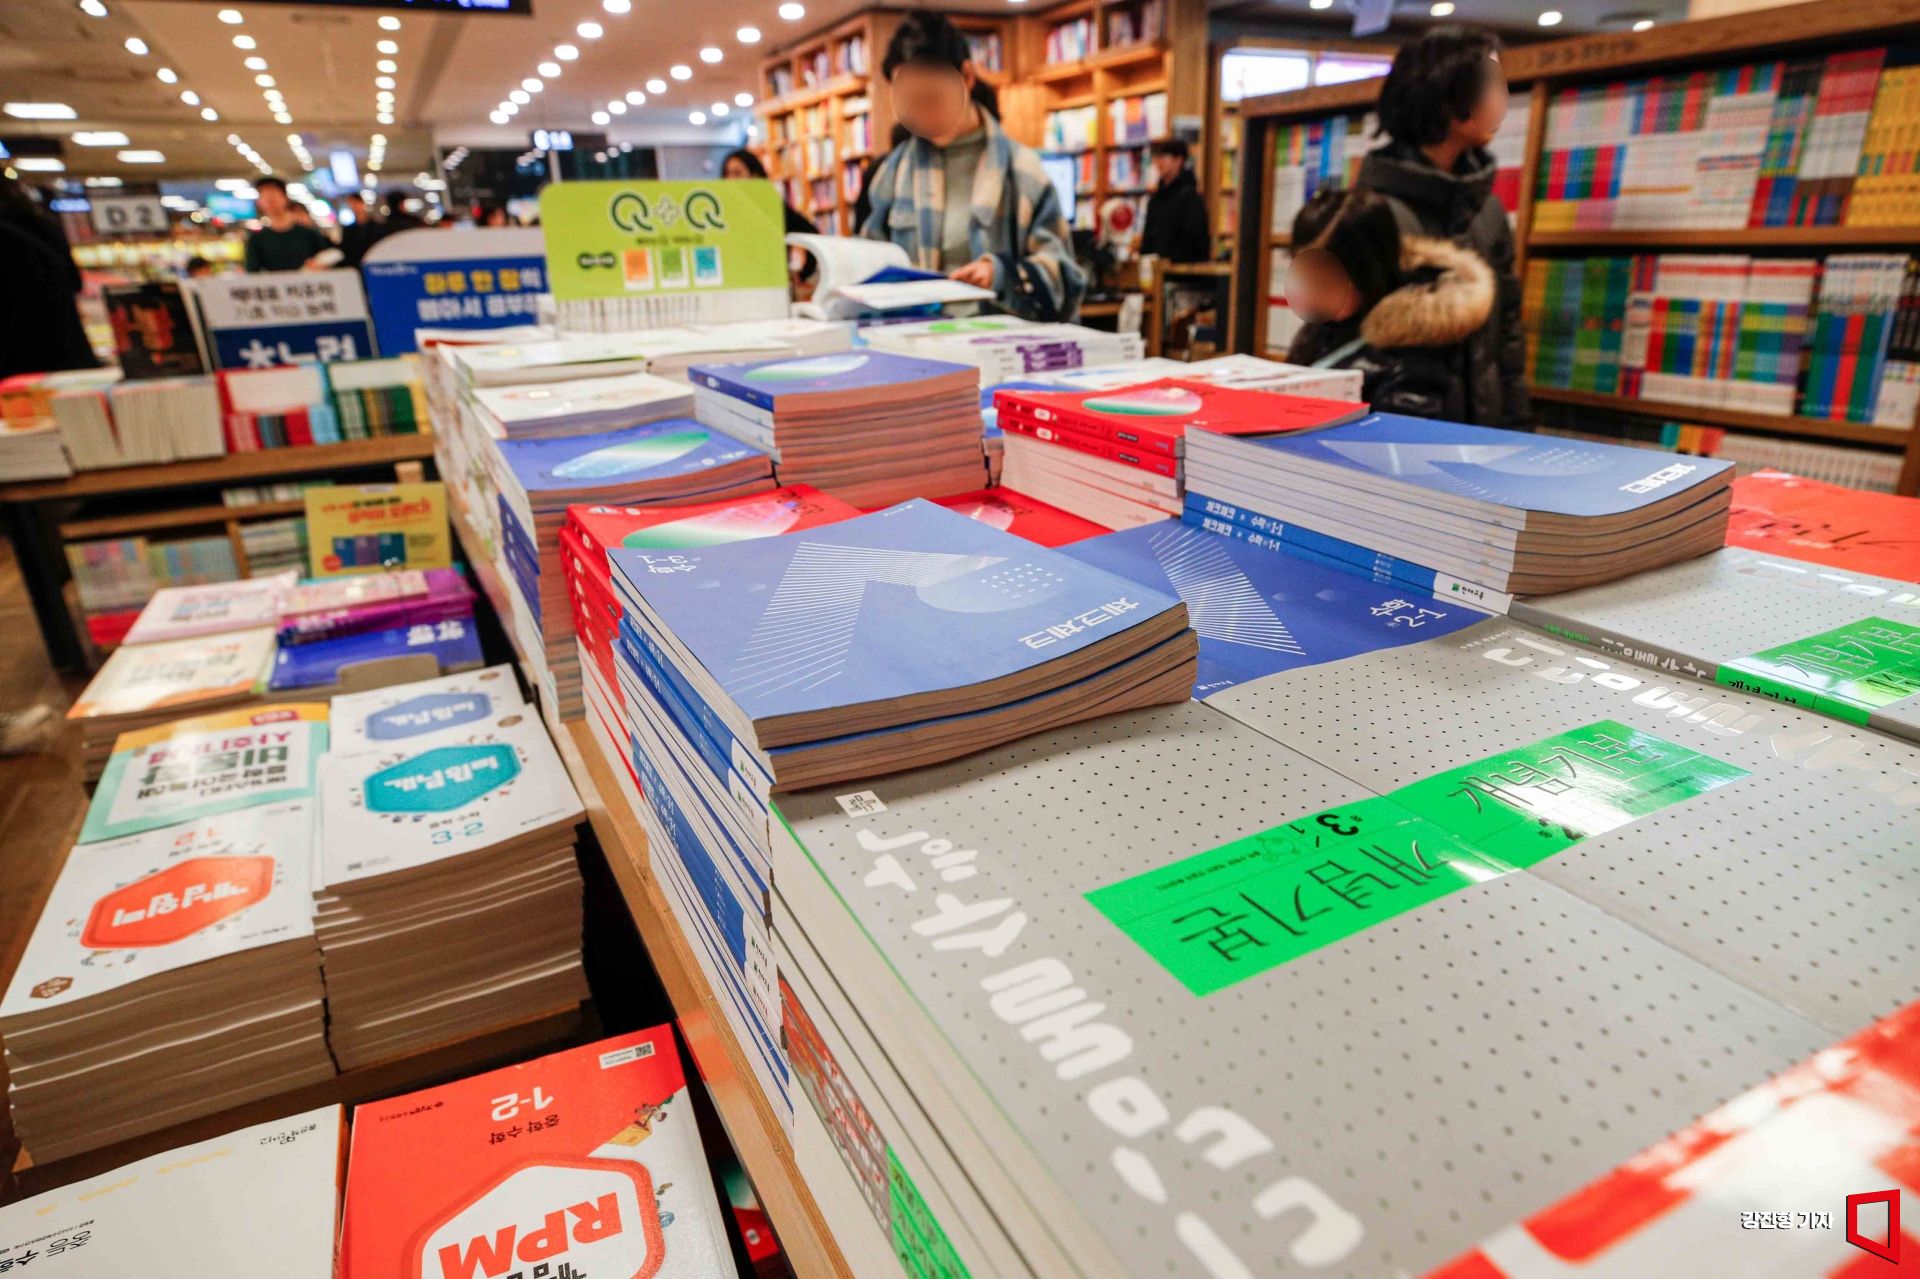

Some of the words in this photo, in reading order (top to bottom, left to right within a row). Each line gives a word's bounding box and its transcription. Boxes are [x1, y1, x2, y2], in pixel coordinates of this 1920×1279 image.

[104, 204, 123, 232] D
[136, 202, 155, 229] 2
[1205, 499, 1237, 520] 체크체크
[1250, 515, 1268, 530] 수학
[1202, 517, 1233, 537] 체크체크
[1247, 532, 1265, 547] 수학
[636, 554, 690, 565] 3-1
[647, 563, 698, 575] 수학
[1369, 598, 1415, 617] 수학
[1393, 608, 1448, 629] 2-1
[1016, 596, 1144, 650] 체크체크
[1447, 734, 1662, 814] 개념기본
[1170, 839, 1447, 964] 개념기본
[490, 1085, 555, 1123] 1-2
[487, 1124, 523, 1146] 수학
[522, 1114, 561, 1138] 중학
[46, 1230, 92, 1258] 중등
[438, 1190, 625, 1279] RPM
